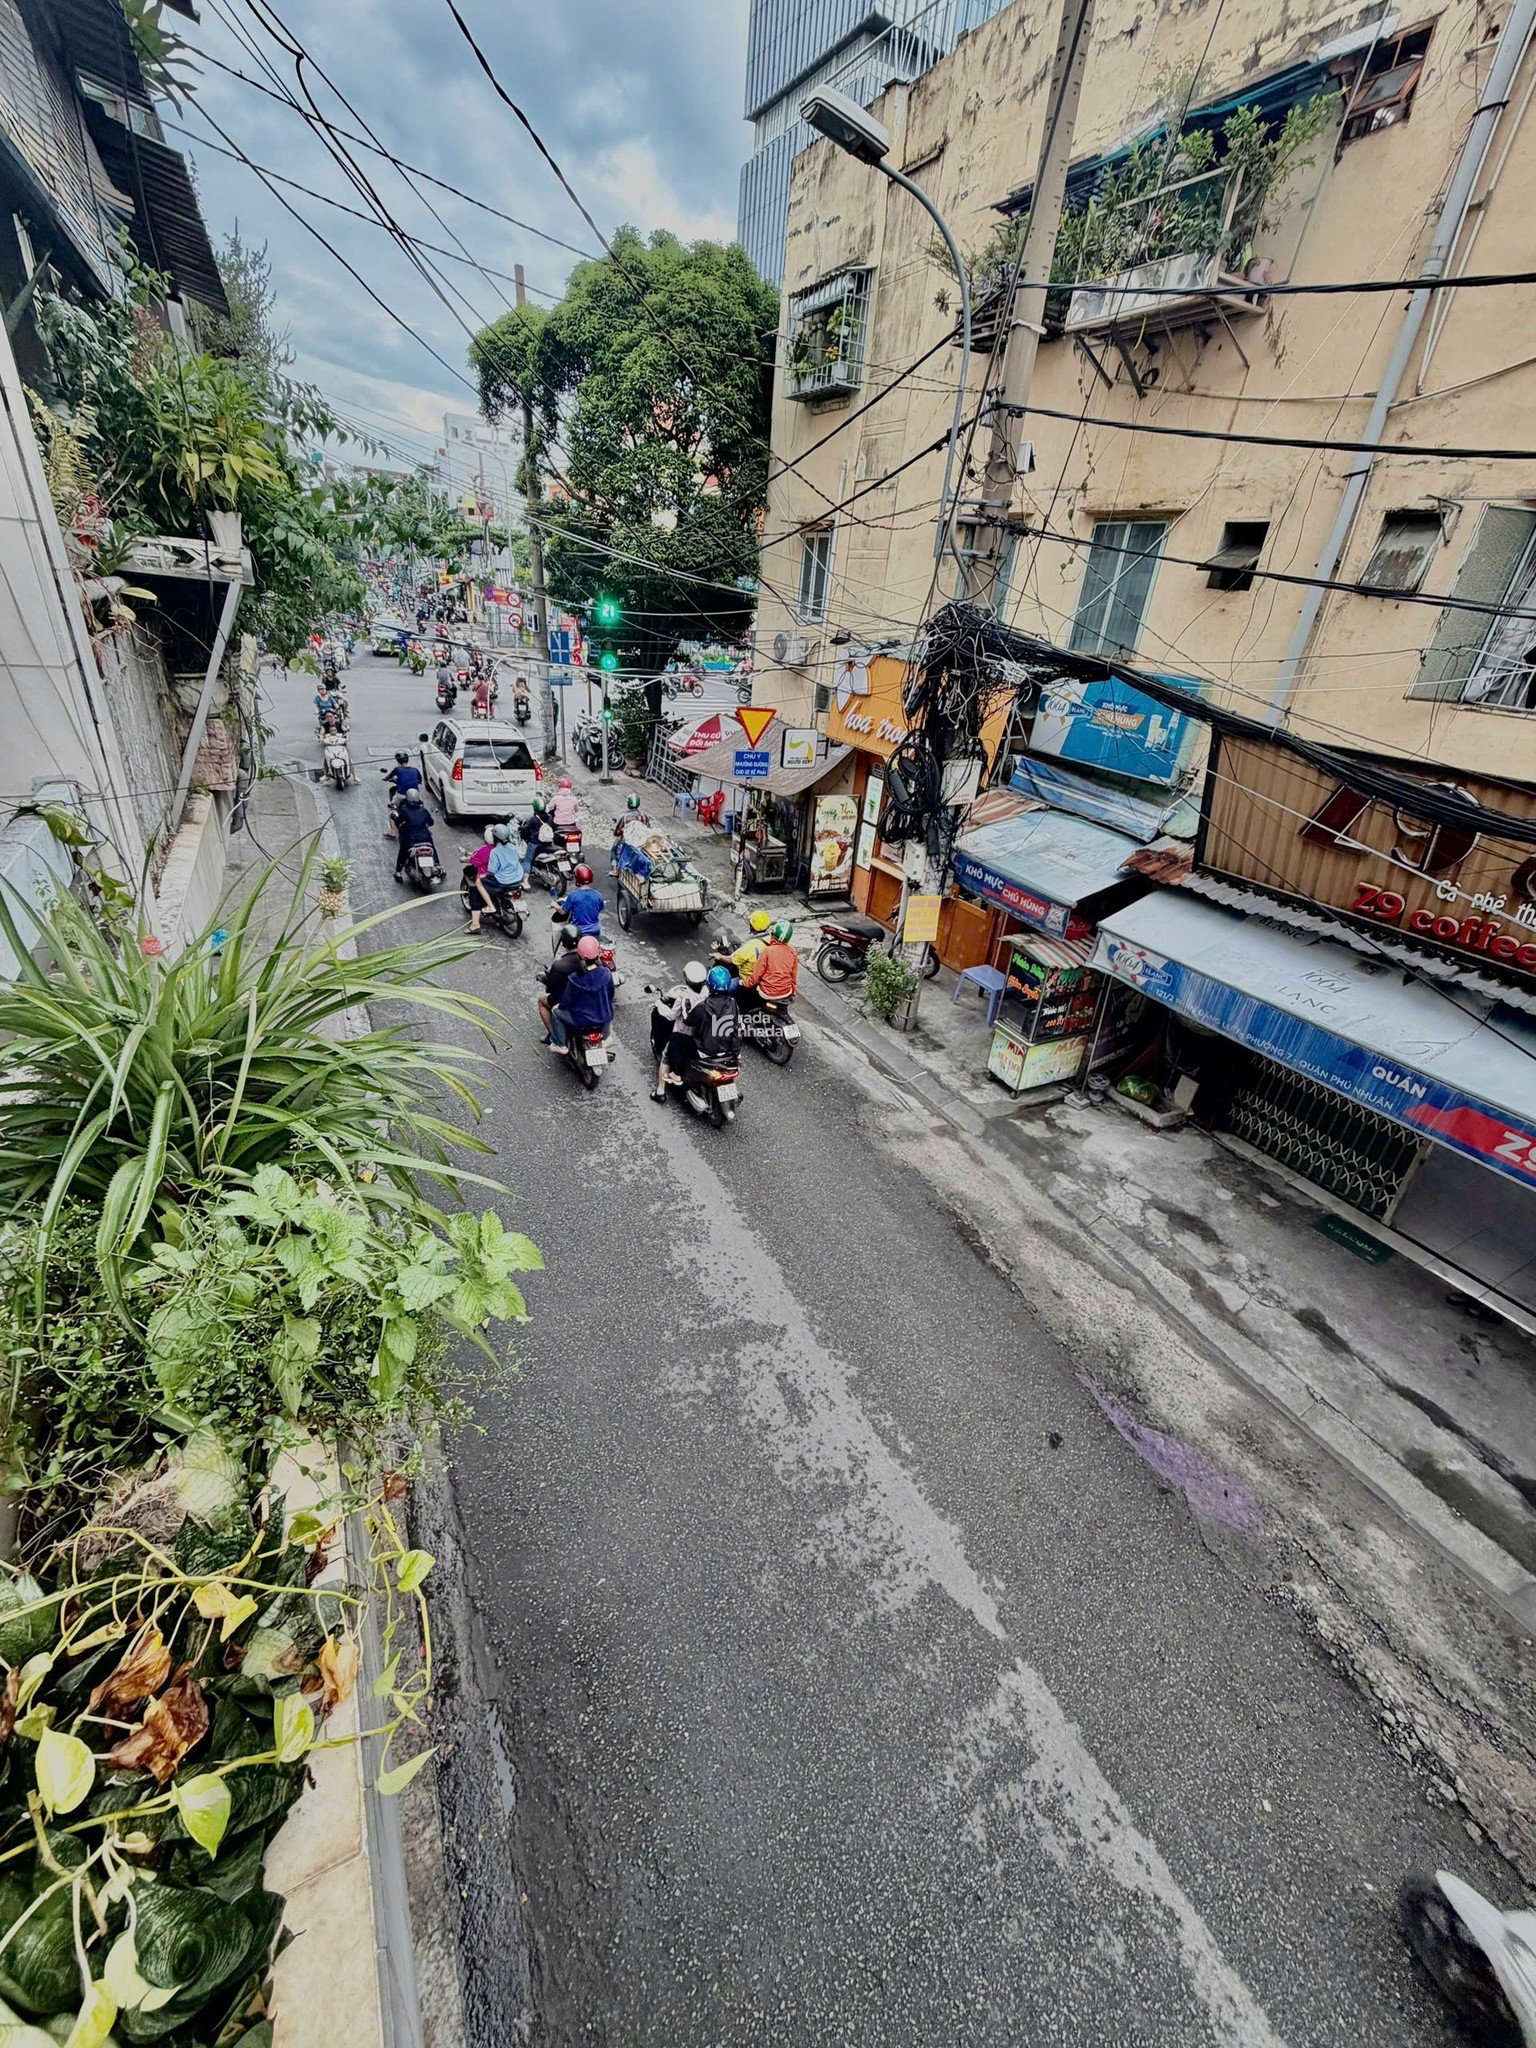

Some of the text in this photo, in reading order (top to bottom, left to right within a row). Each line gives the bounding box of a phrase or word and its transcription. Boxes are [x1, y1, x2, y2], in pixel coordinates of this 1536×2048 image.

[845, 700, 873, 734] hoa
[693, 731, 710, 739] THU
[965, 864, 1005, 890] KHÔ MỰC
[1002, 888, 1020, 903] CHÚ
[1020, 898, 1045, 916] HÙNG
[1436, 880, 1462, 903] Cà
[1471, 892, 1508, 914] phê
[1353, 881, 1536, 966] Z9 coffee
[1115, 951, 1141, 971] 1664
[1155, 988, 1175, 1003] 121/2
[1286, 1052, 1294, 1061] 7
[1330, 1073, 1352, 1090] PHÚ
[1354, 1086, 1395, 1111] NHUẬN
[1371, 1065, 1429, 1100] QUÁN
